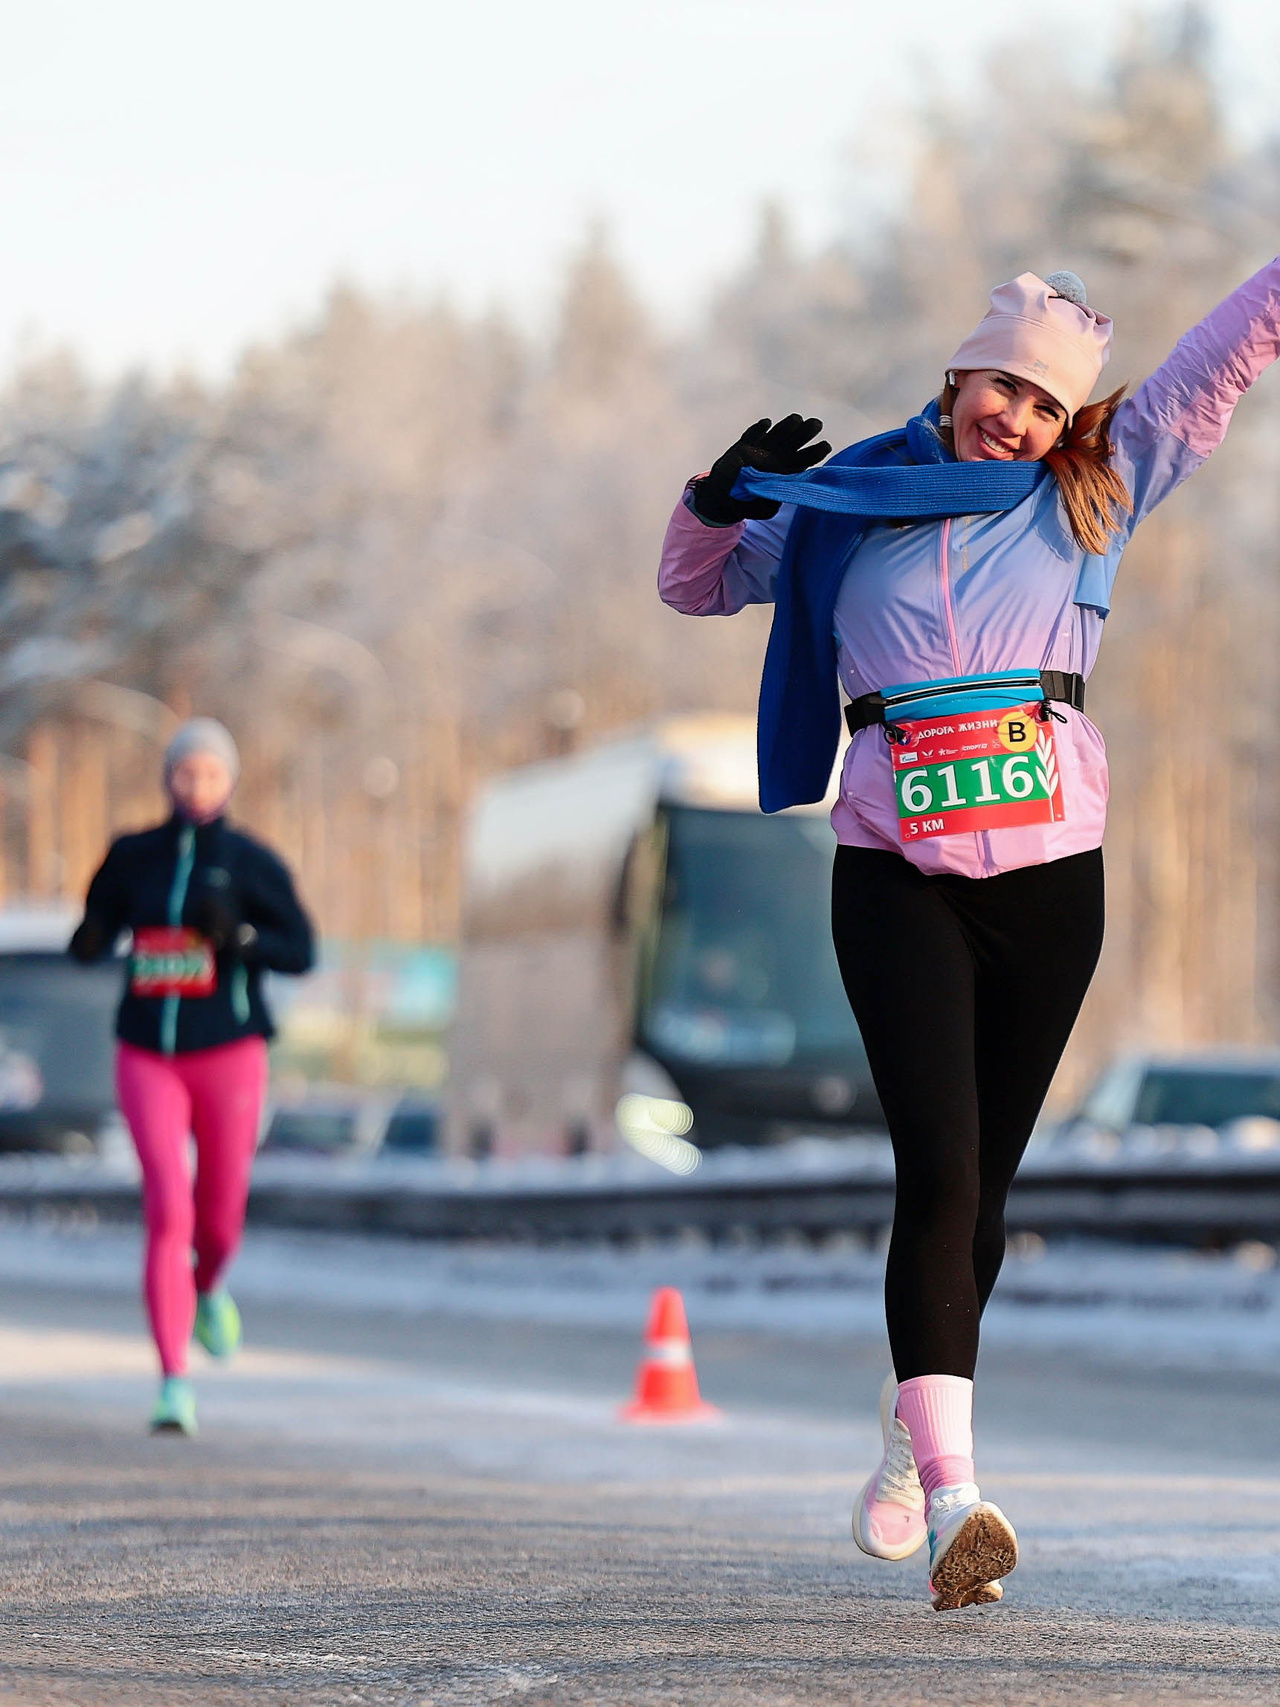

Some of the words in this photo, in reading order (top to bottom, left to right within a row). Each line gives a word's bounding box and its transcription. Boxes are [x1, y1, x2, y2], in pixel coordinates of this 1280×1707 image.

[917, 726, 955, 740] ДОРОГА
[958, 719, 998, 733] ЖИЗНИ
[901, 755, 1034, 813] 6116
[909, 822, 919, 835] 5
